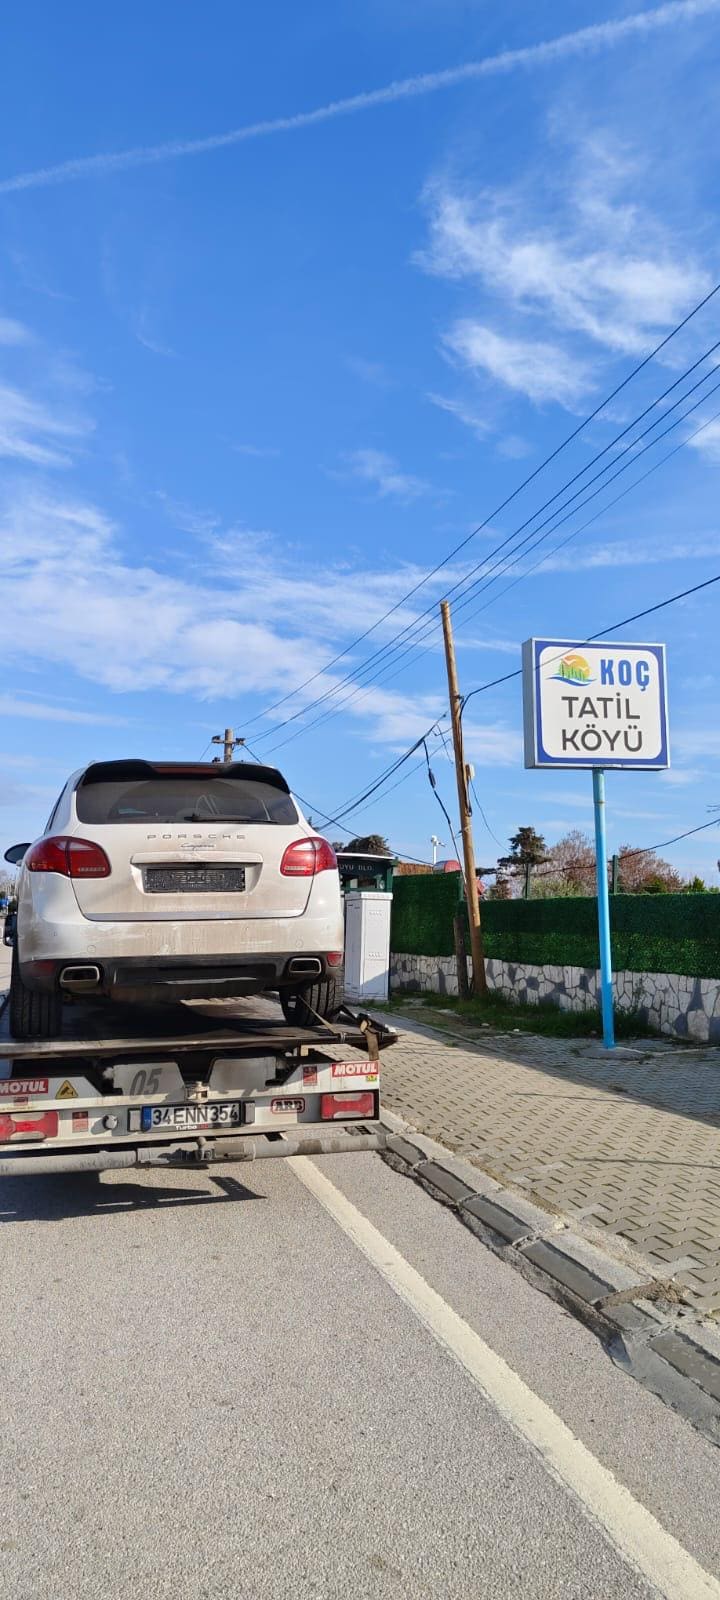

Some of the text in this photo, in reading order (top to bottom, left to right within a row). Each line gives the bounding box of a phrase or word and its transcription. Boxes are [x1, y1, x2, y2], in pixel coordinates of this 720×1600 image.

[600, 659, 650, 691] KOÇ
[561, 692, 640, 719] TATİL
[561, 723, 642, 752] KÖYÜ
[333, 1063, 377, 1075] MOTUL
[0, 1081, 46, 1094] MOTUL
[129, 1068, 161, 1099] 05
[275, 1101, 303, 1111] ARB
